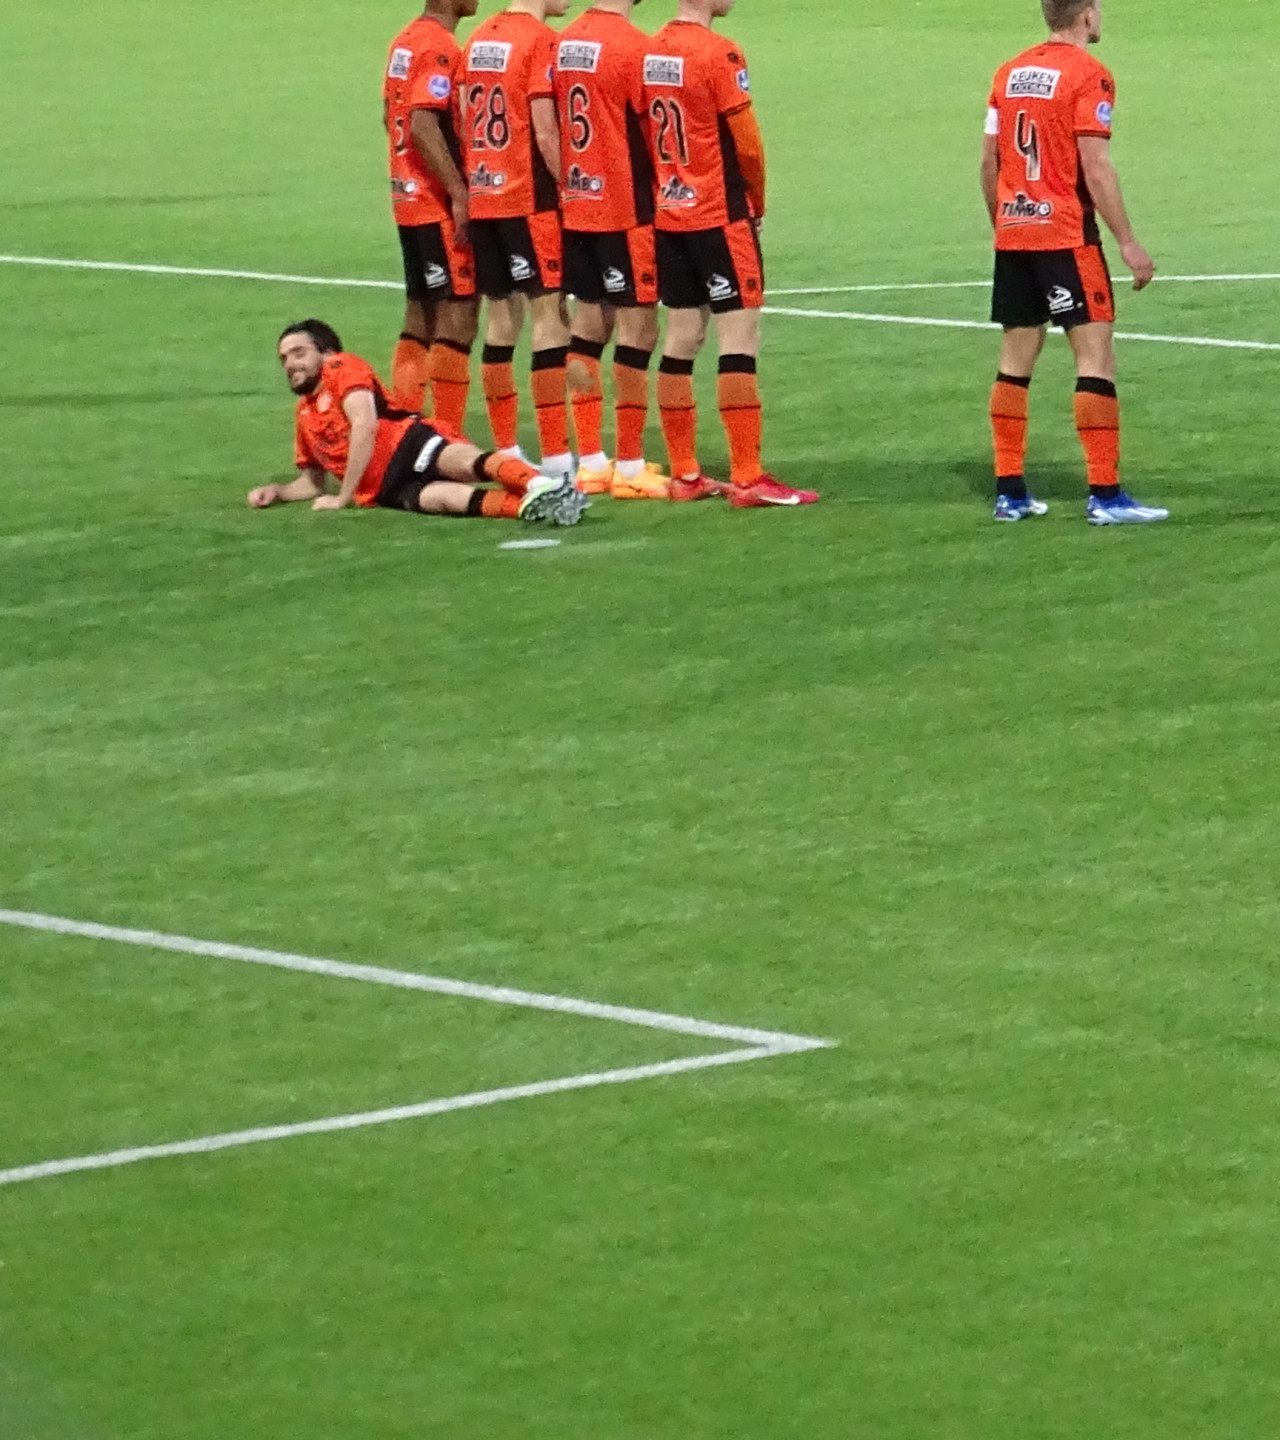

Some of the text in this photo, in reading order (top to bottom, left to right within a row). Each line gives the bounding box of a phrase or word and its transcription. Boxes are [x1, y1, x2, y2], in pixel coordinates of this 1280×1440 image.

[467, 83, 511, 150] 28
[568, 83, 593, 152] 6
[650, 96, 690, 166] 21
[1014, 110, 1042, 180] 4
